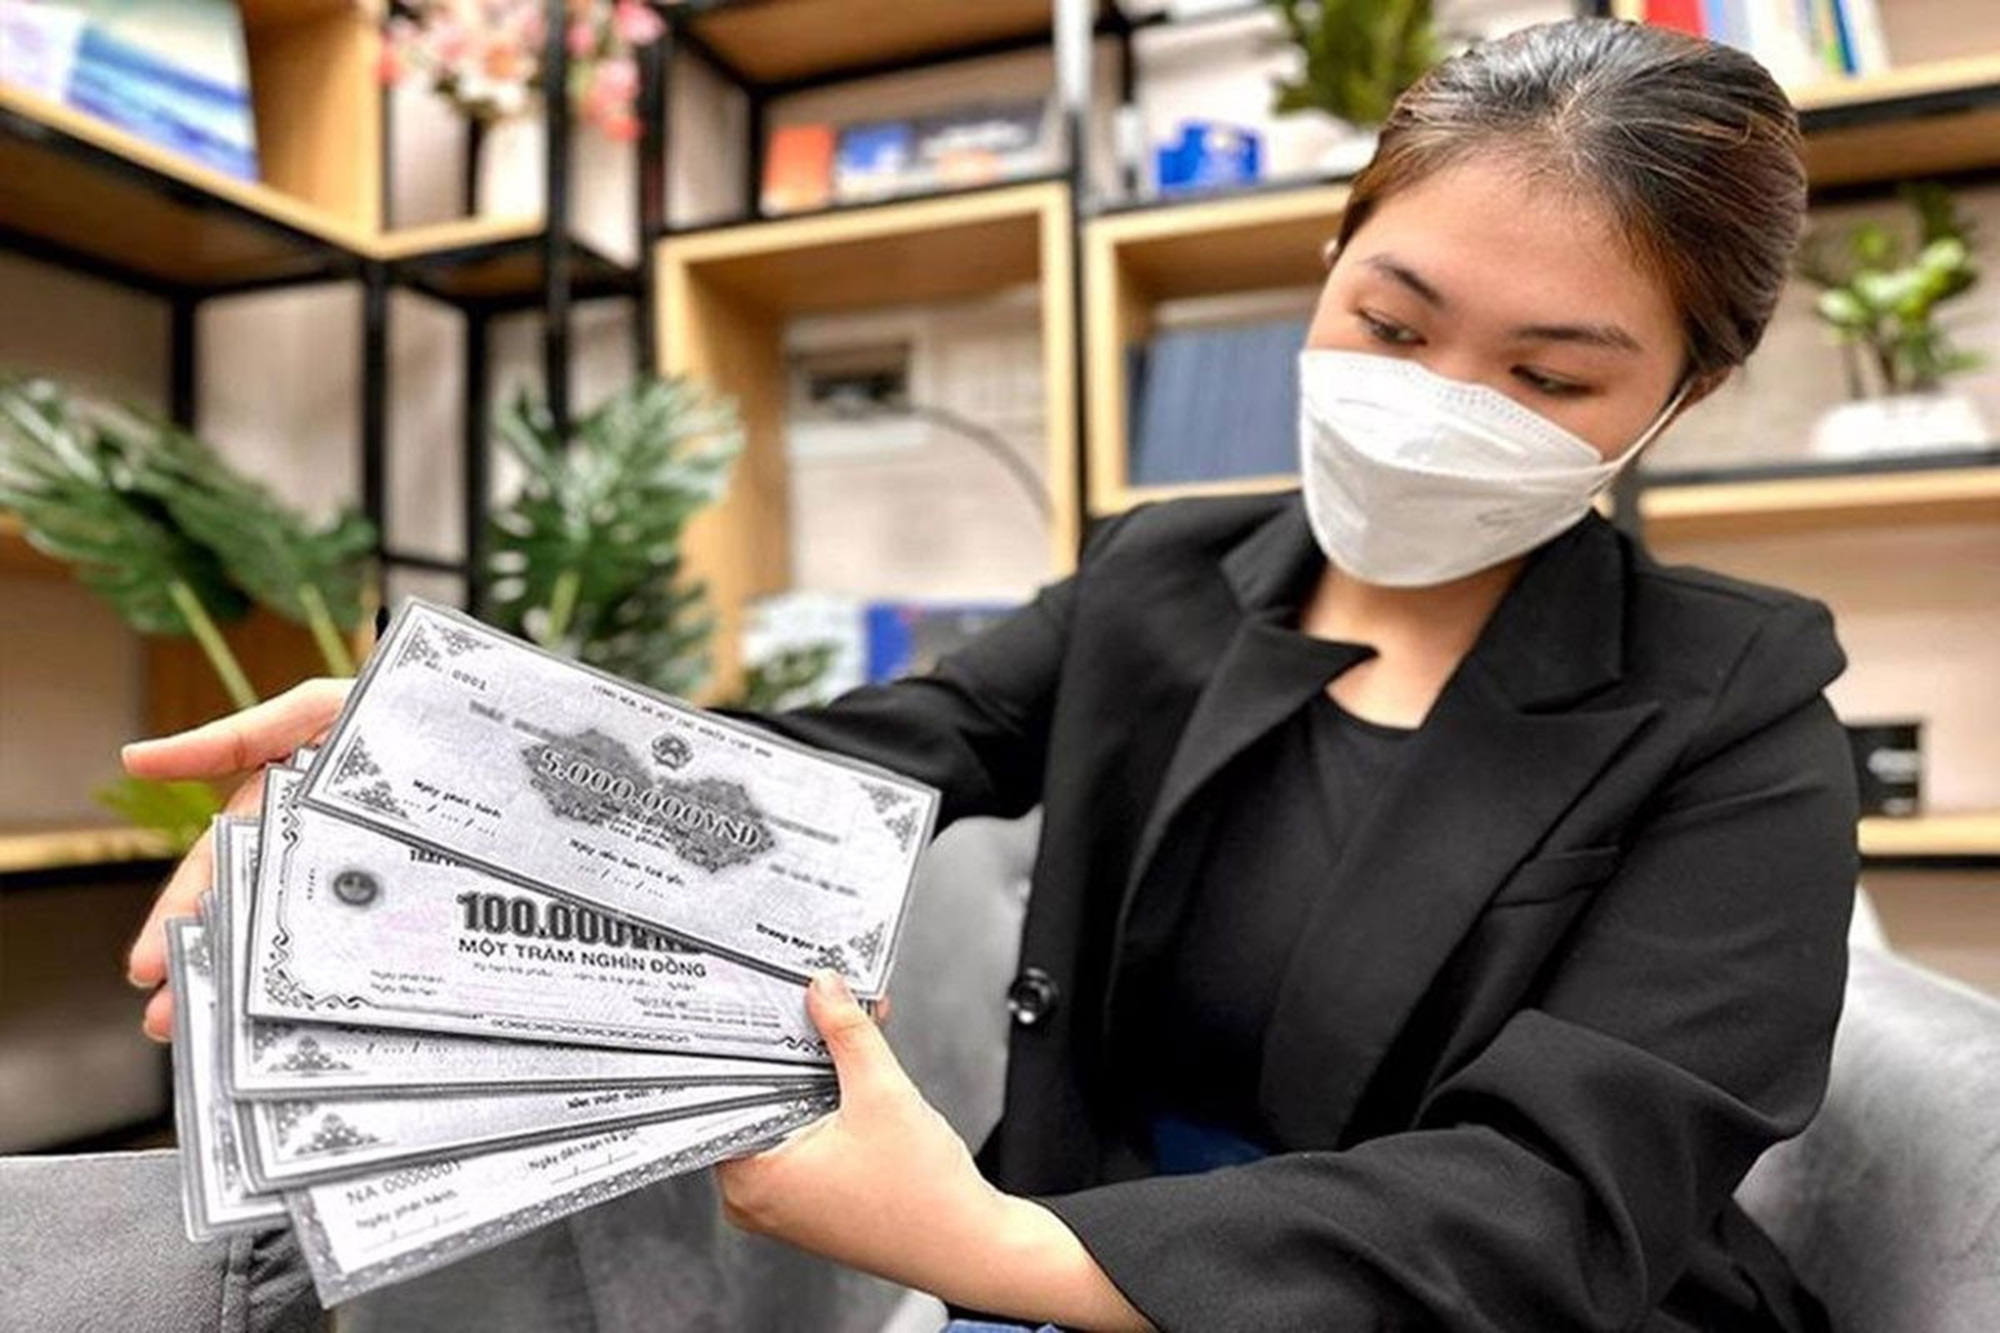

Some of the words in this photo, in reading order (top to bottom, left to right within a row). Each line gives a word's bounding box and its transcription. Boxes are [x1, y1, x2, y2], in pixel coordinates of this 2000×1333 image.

[458, 937, 509, 958] MỘT
[514, 943, 576, 965] TRĂM
[581, 951, 646, 972] NGHÌN
[649, 954, 707, 978] ĐỒNG
